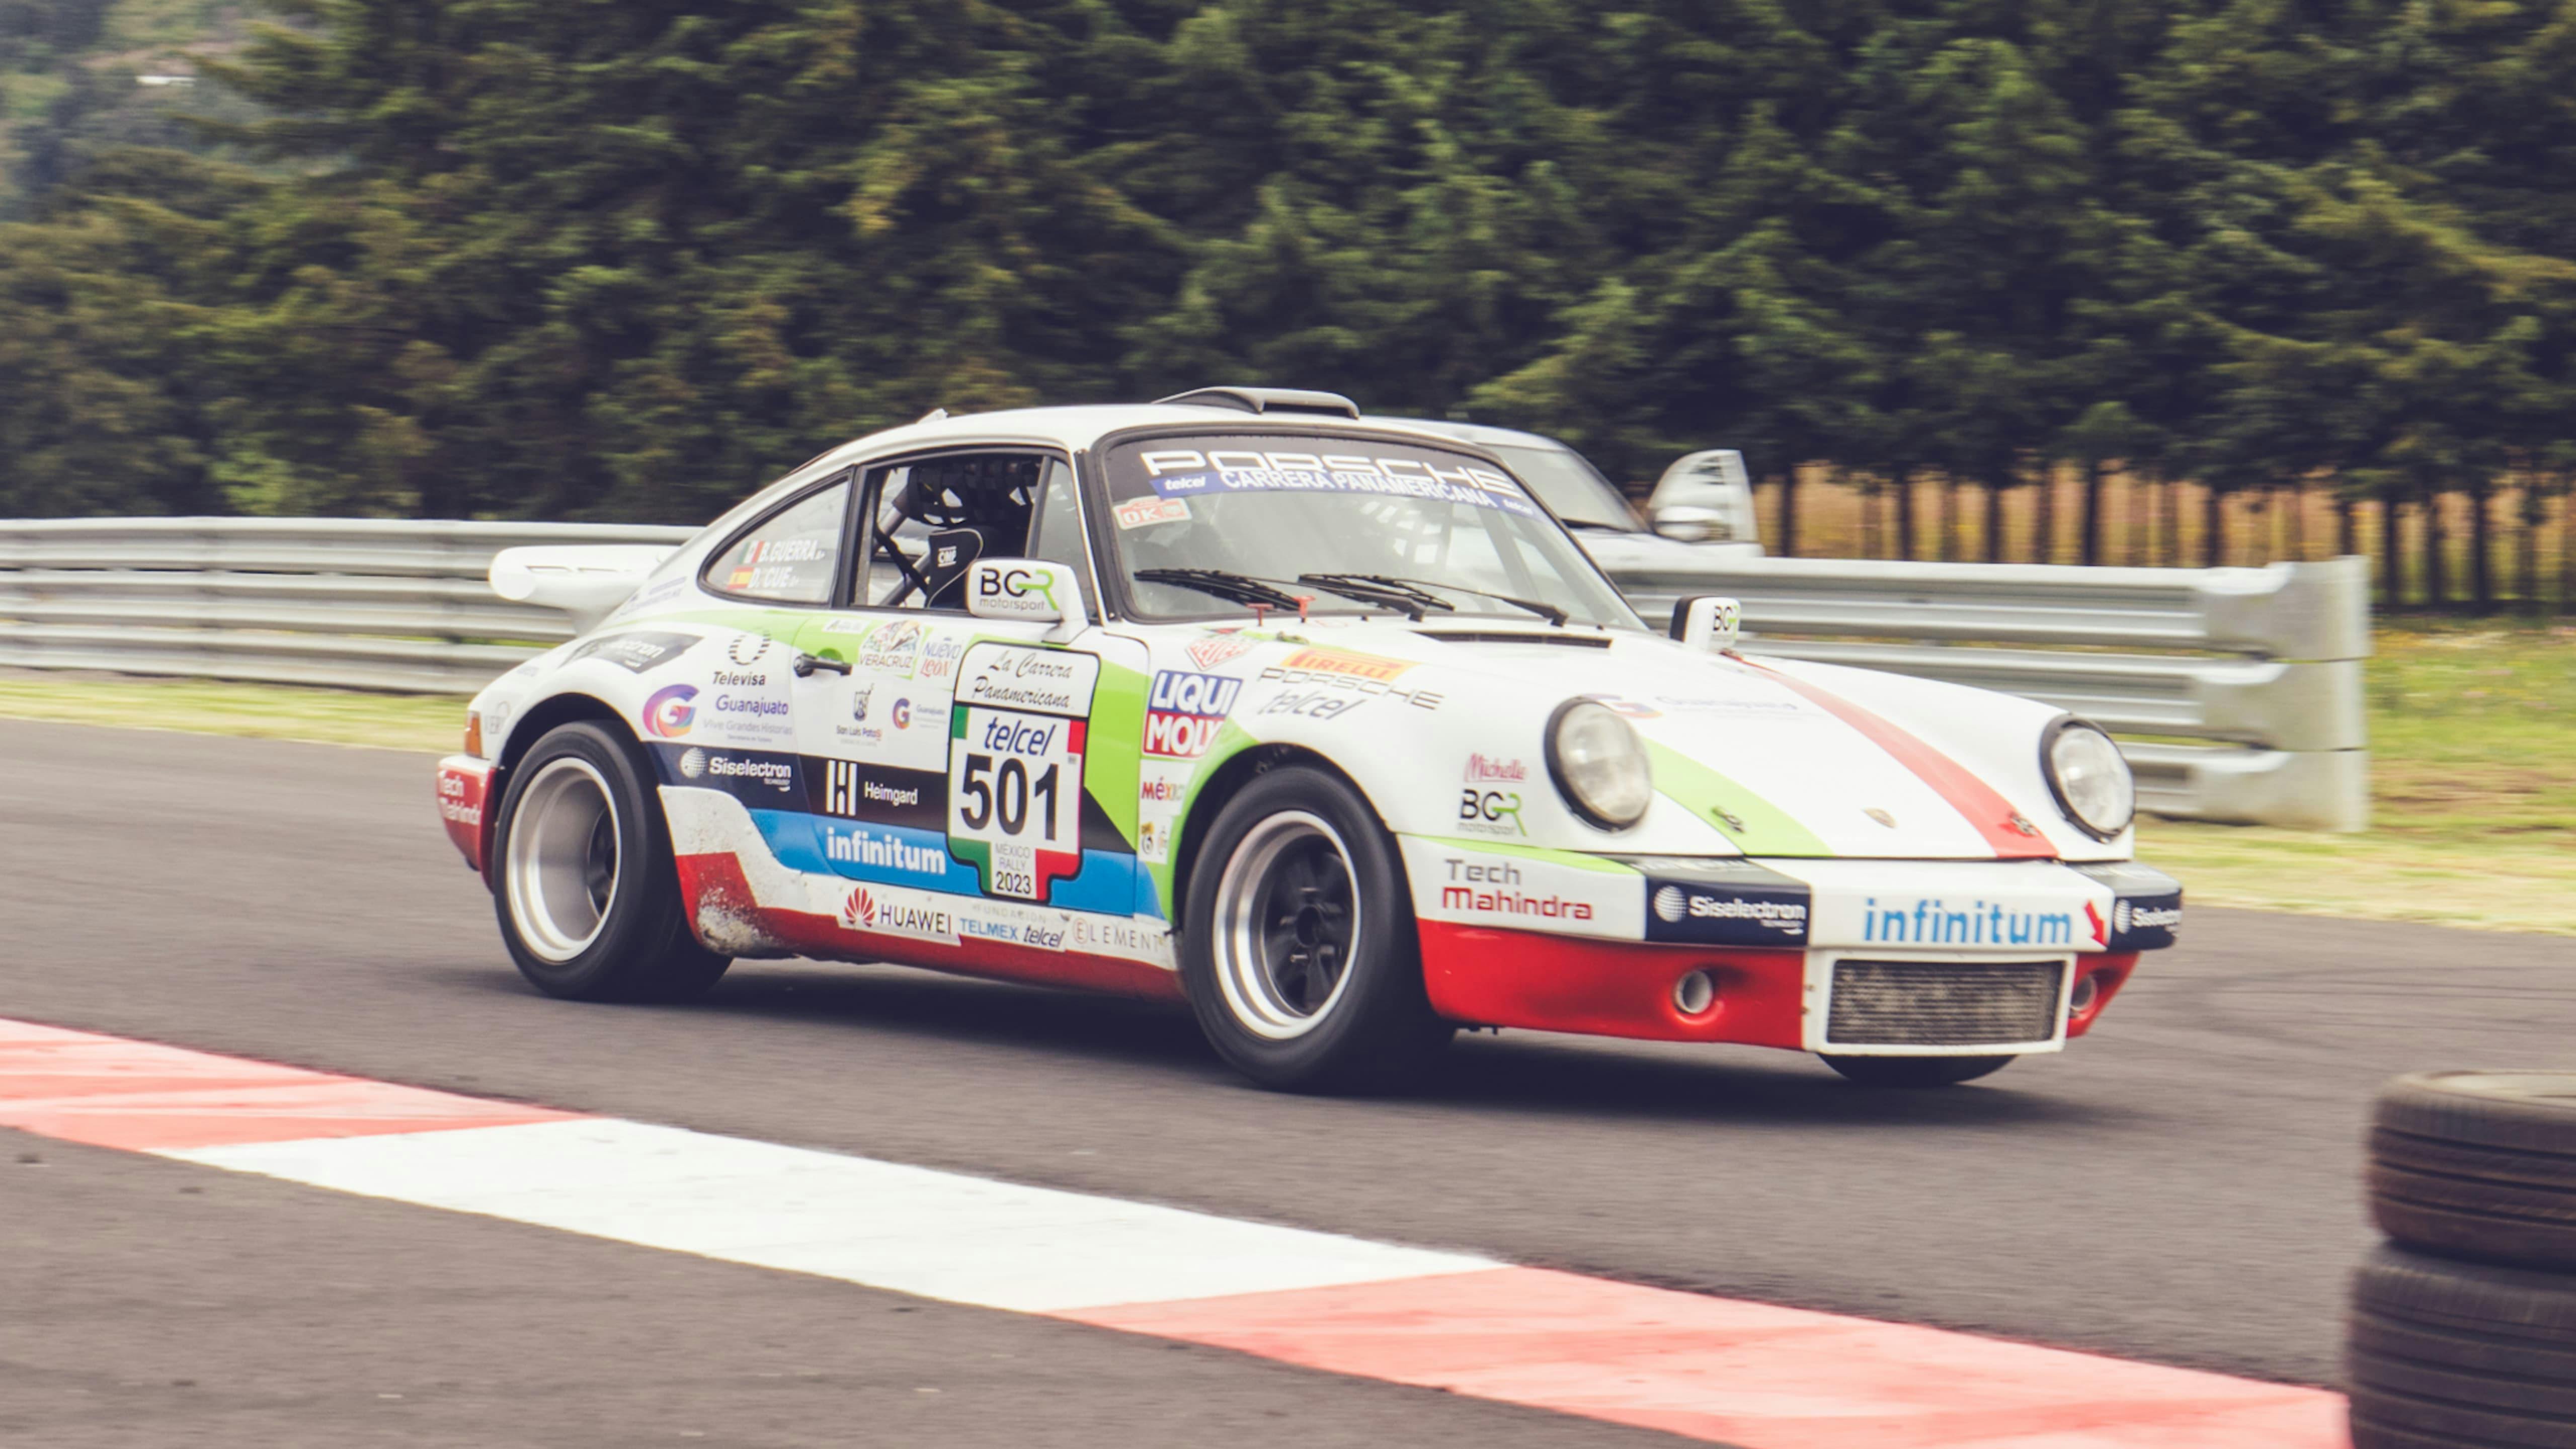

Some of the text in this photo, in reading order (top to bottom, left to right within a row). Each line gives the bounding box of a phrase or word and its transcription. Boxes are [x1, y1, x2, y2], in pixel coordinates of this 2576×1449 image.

[1141, 450, 1520, 498] PORSCHE
[1164, 475, 1206, 492] telcel
[1220, 470, 1330, 491] CARRERA
[1333, 472, 1497, 508] PANAMERICANA
[1122, 507, 1159, 524] OK
[979, 598, 1045, 611] motorsport
[980, 568, 1058, 611] BGR
[712, 671, 766, 686] Televisa
[989, 650, 1073, 679] La Carrera
[1290, 649, 1402, 679] PIRELLI
[972, 675, 1071, 708] Panamericana
[1151, 672, 1241, 714] LIQUI
[1257, 667, 1445, 710] PORSCHE
[715, 694, 789, 718] Guanajuato
[1257, 689, 1368, 720] telcel
[984, 716, 1057, 756] telcel
[1145, 713, 1225, 755] MOLY
[709, 757, 792, 779] Siselectron
[864, 781, 918, 806] Heimgard
[960, 753, 1059, 841] 501
[1459, 788, 1527, 837] BGR
[827, 827, 946, 875] infinitum
[998, 857, 1027, 872] RALLY
[996, 870, 1031, 895] 2023
[1444, 858, 1521, 886] Tech
[880, 903, 951, 934] HUAWEI
[1442, 886, 1593, 920] Mahindra
[1689, 896, 1806, 920] Siselectron
[959, 918, 1066, 947] TELMEX telcel
[1864, 898, 2072, 944] infinitum
